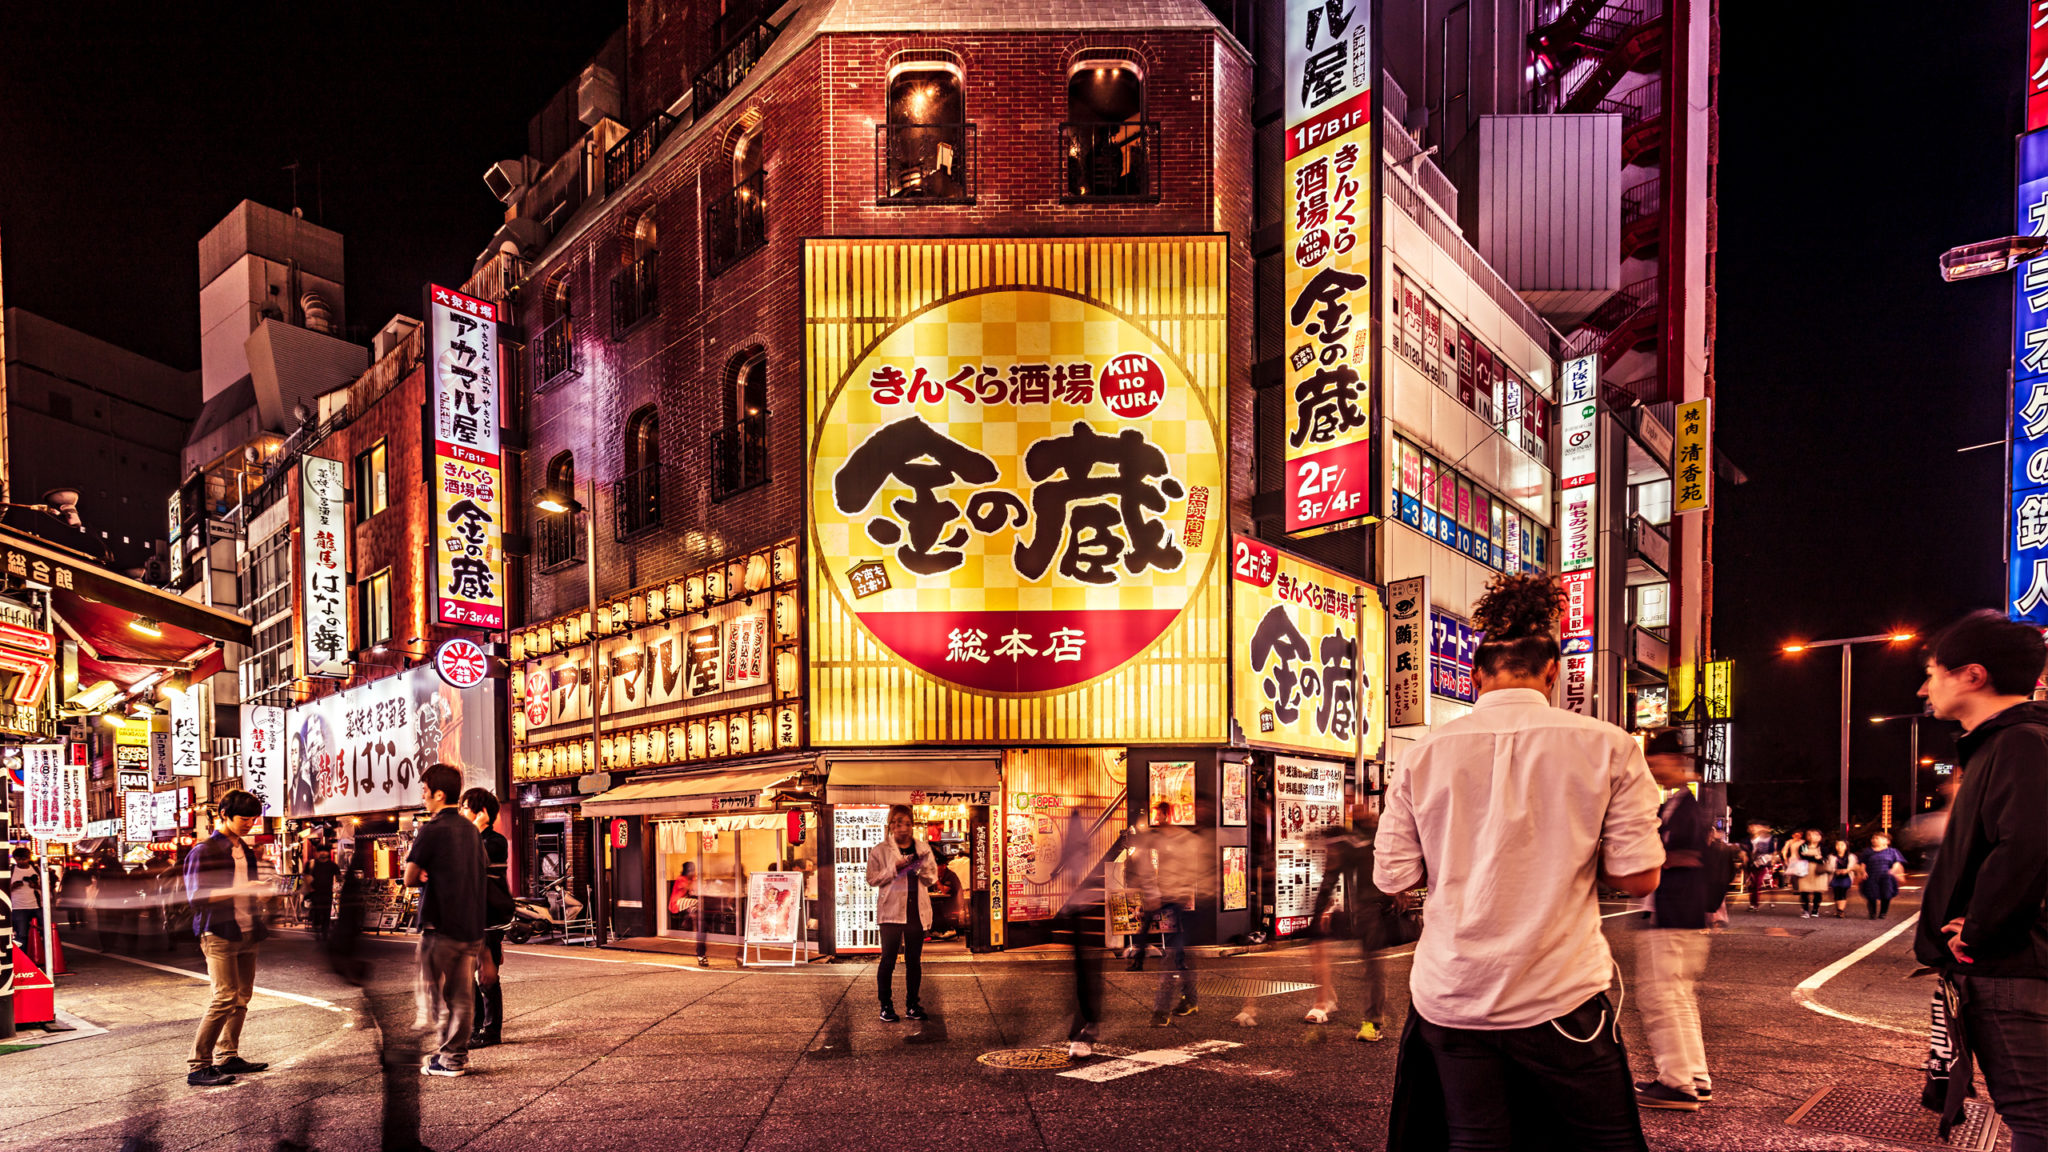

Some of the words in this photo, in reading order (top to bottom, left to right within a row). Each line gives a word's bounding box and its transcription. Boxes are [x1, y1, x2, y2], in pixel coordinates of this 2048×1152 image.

[1294, 108, 1363, 150] 1F/B1F
[1295, 156, 1328, 231] 酒場
[1333, 142, 1359, 255] きんくら
[1299, 247, 1328, 267] KURA
[1301, 231, 1322, 246] KIN
[436, 290, 493, 320] 大衆酒場
[1107, 356, 1149, 376] KIN
[1289, 266, 1368, 448] 金の蔵
[1404, 341, 1449, 389] 0120-4-5511
[450, 311, 482, 445] アカマル屋
[870, 364, 1094, 405] きんくら酒場
[1118, 376, 1145, 389] no
[1572, 359, 1588, 400] 手塚ビル
[1105, 390, 1161, 410] KURA
[1684, 408, 1700, 436] 焼肉
[444, 462, 494, 485] きんくら
[451, 445, 486, 464] 1F/B1F
[1680, 443, 1703, 504] 清香苑
[444, 478, 475, 499] 酒場
[834, 416, 1185, 584] 金の蔵
[1404, 451, 1489, 533] 新宿整骨院
[1570, 477, 1585, 486] 4F
[1183, 486, 1208, 548] 登録商標
[1298, 492, 1361, 523] 3F/4F
[313, 530, 337, 570] 龍馬
[447, 500, 495, 599] 金の蔵
[852, 565, 885, 584] 今宵も
[857, 578, 887, 598] 立寄り
[310, 571, 345, 661] はなの舞
[1277, 572, 1349, 620] きんくら酒場
[1572, 583, 1582, 629] 高価買取
[945, 628, 1086, 663] 総本店
[1395, 624, 1412, 673] 鮪氏
[551, 624, 719, 720] アカマル屋
[1250, 604, 1370, 742] 金の蔵
[1567, 657, 1586, 714] 新宿ピア
[708, 725, 716, 750] つくね
[730, 723, 740, 745] かわ
[781, 712, 793, 743] もつ煮
[121, 774, 147, 787] BAR
[316, 748, 350, 798] 龍馬
[926, 791, 991, 805] アカマル屋
[992, 809, 1000, 863] きんくら酒場
